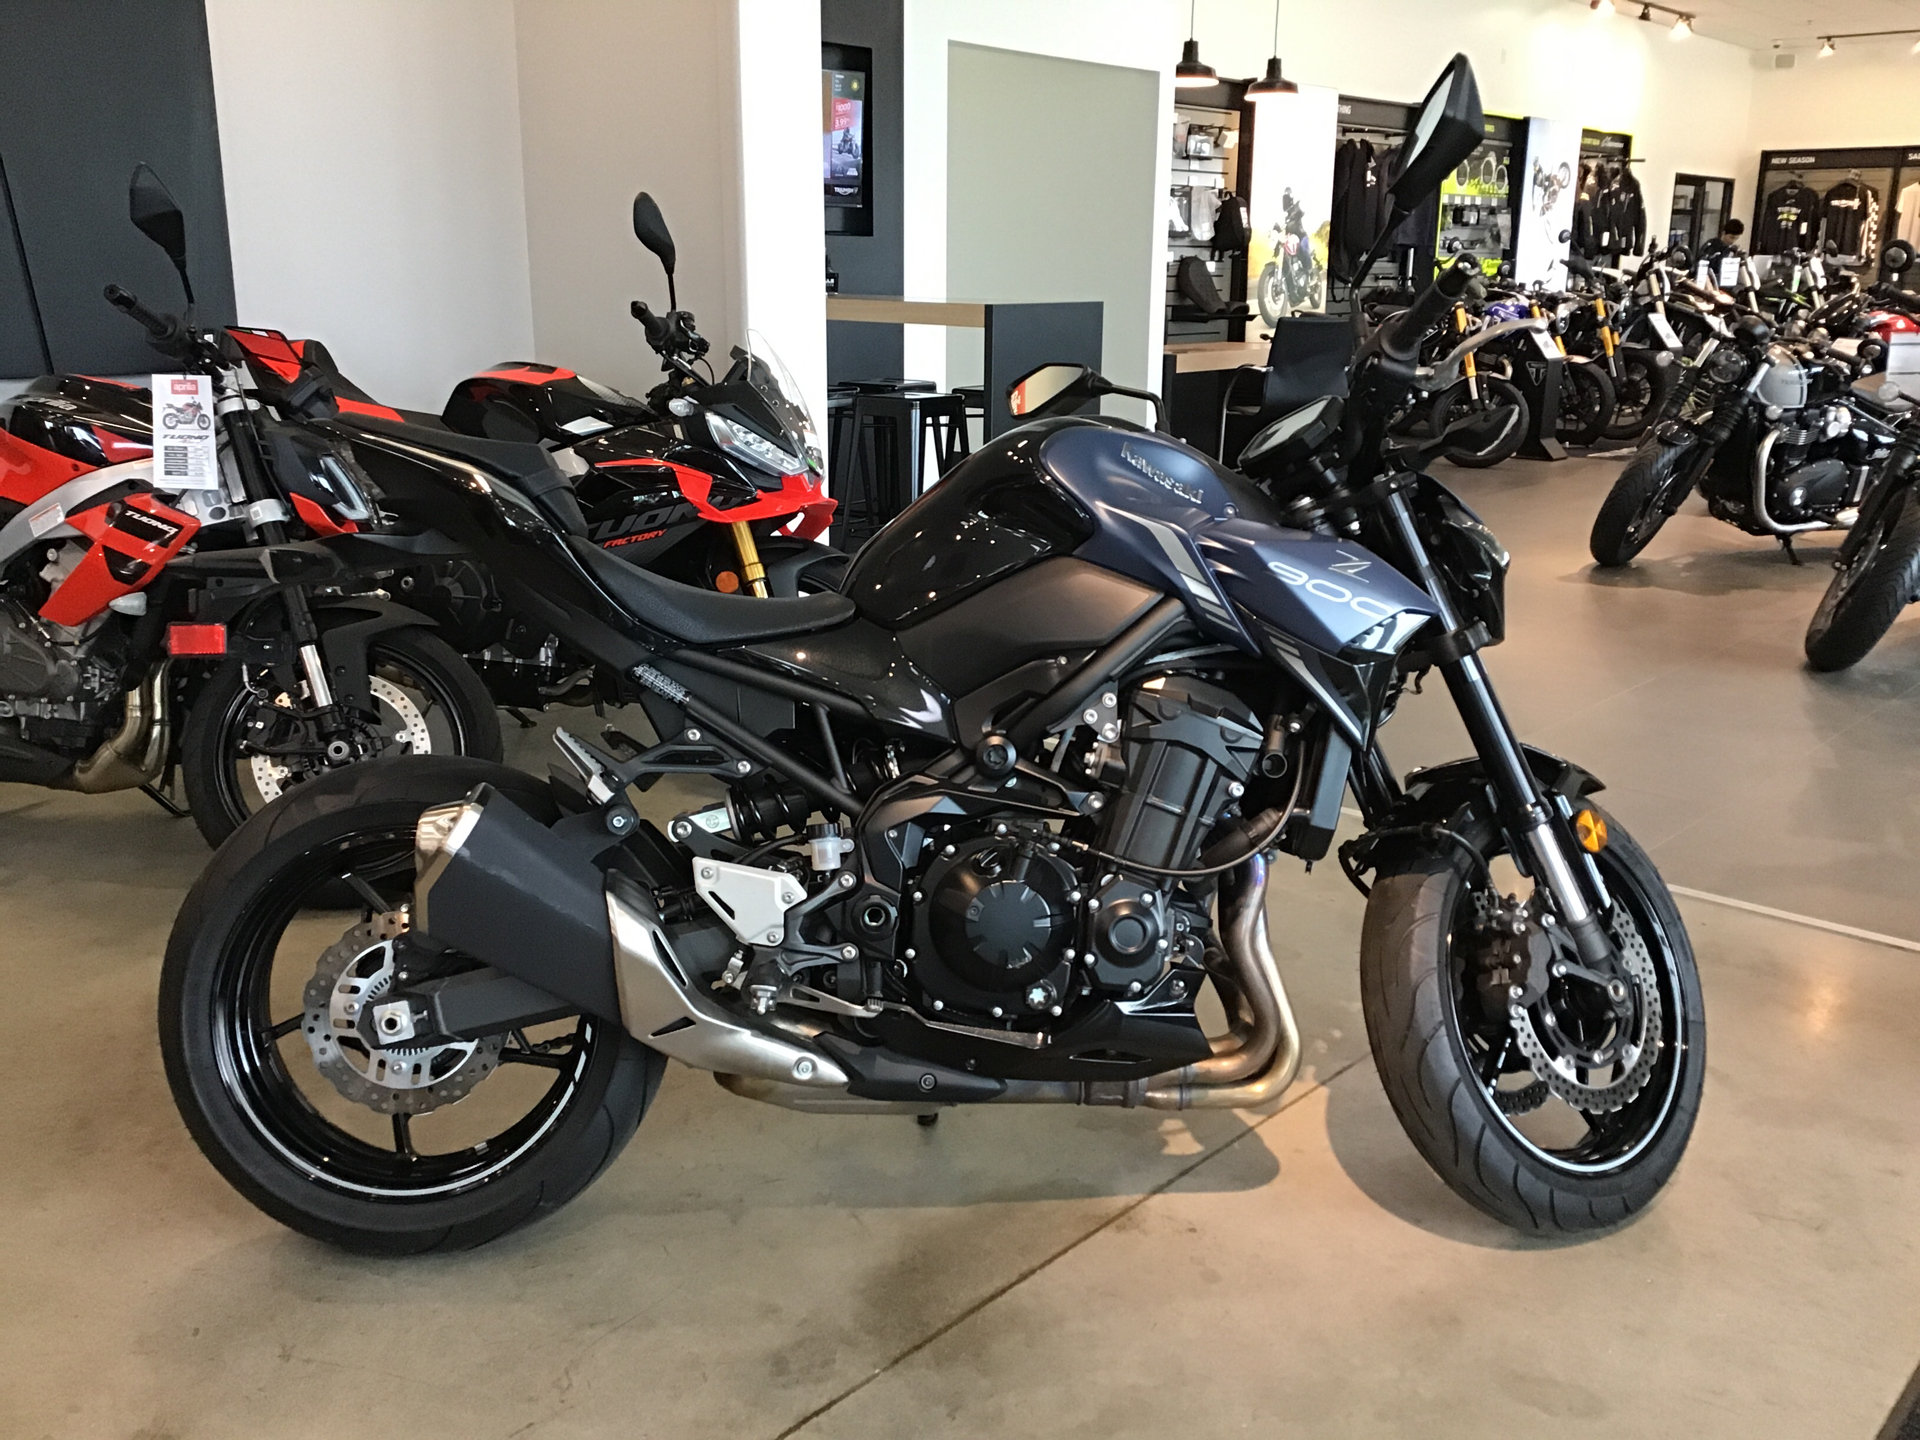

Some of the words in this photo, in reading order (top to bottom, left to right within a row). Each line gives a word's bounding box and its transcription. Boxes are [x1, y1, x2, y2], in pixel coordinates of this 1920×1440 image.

[1771, 157, 1788, 165] NEW
[1788, 156, 1816, 164] SEASON
[173, 383, 197, 393] aprilia
[1121, 441, 1204, 504] Kawasaki
[125, 510, 179, 534] TUONO
[603, 529, 667, 549] FACTORY
[1267, 561, 1397, 620] 900
